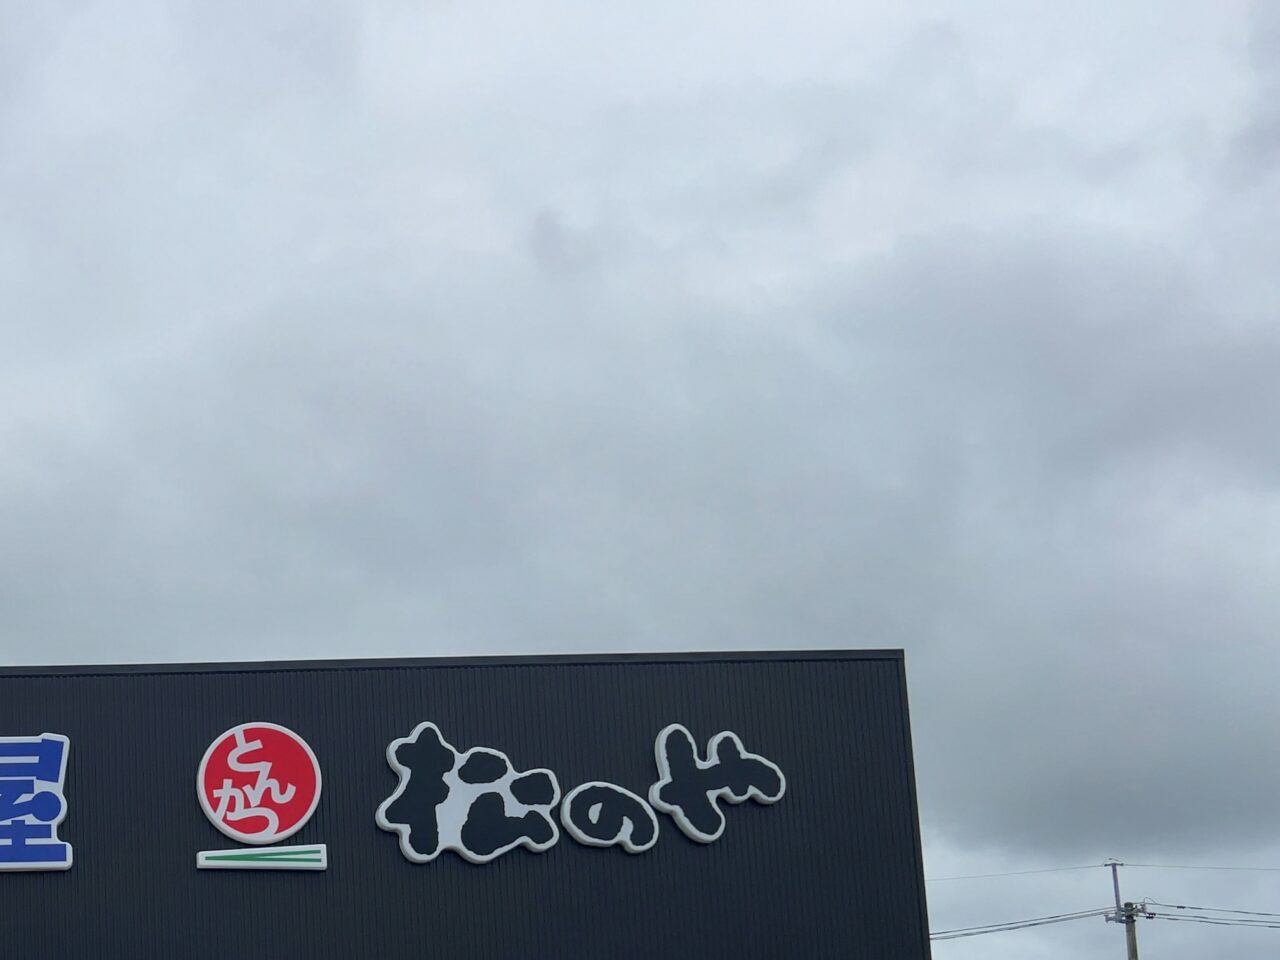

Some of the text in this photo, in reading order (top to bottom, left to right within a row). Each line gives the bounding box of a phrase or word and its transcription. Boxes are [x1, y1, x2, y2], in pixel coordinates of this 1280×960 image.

[213, 727, 297, 838] とんかつ
[376, 722, 786, 863] 松のや
